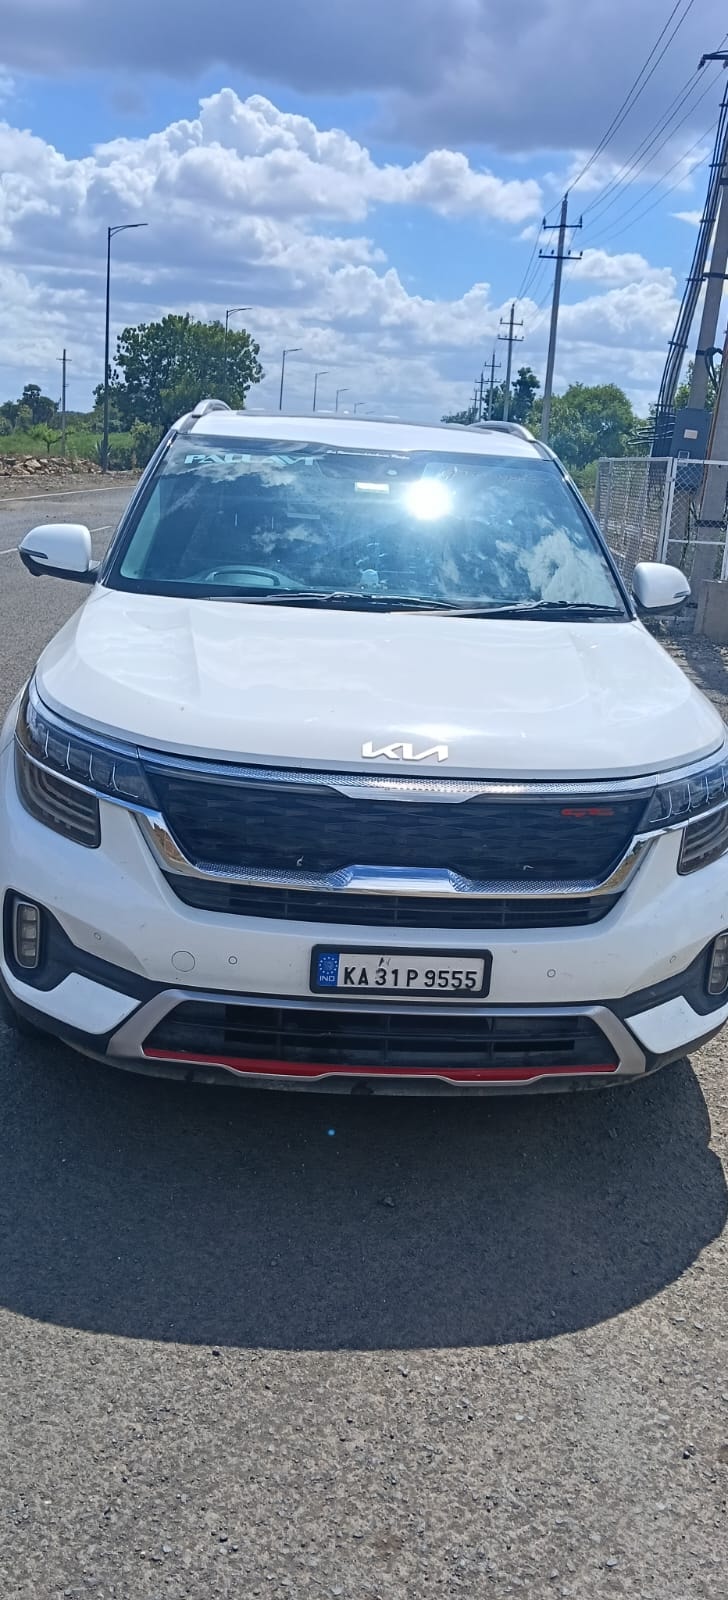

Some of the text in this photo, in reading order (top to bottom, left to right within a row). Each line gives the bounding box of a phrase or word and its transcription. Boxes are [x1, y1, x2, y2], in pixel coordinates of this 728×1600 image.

[361, 741, 449, 763] KIA
[343, 966, 478, 989] KA 31 P 9555
